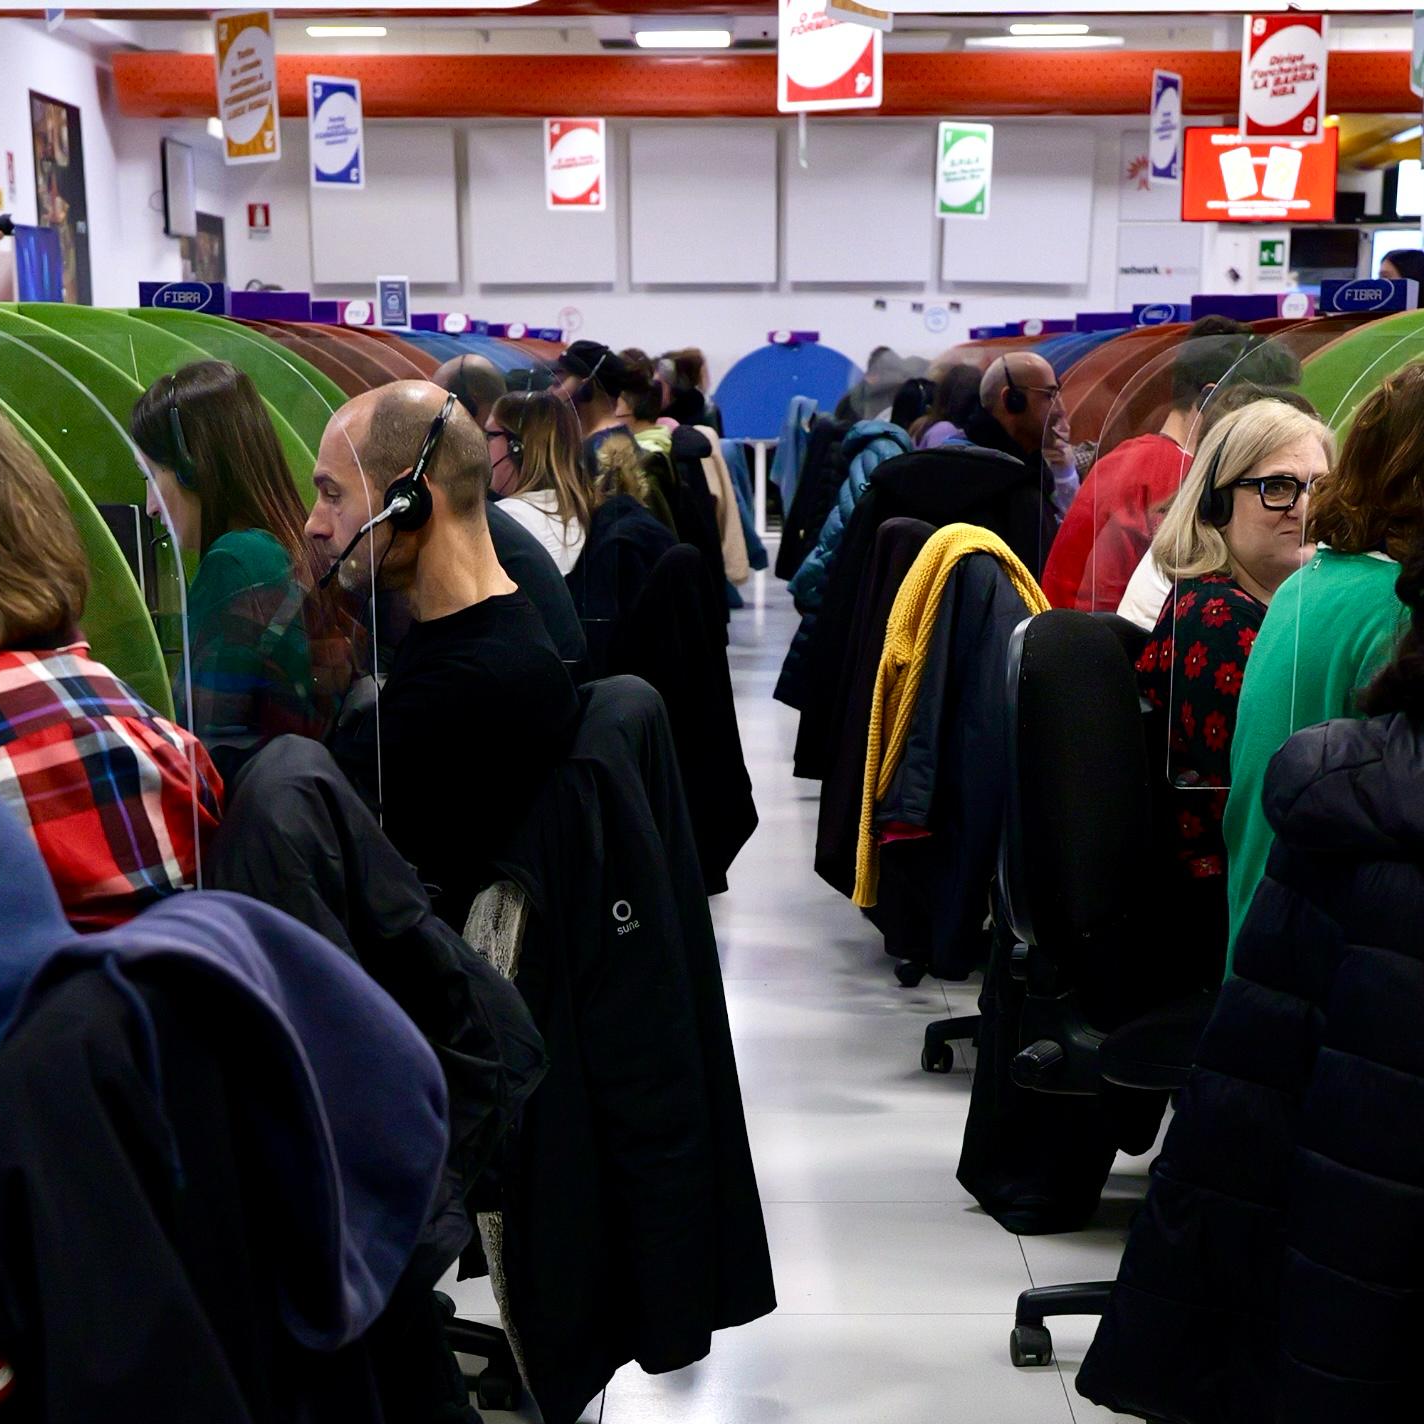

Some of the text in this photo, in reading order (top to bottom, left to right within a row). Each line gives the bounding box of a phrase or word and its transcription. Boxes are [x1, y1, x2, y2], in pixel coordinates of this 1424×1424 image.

[1252, 18, 1267, 36] 8
[1253, 79, 1268, 90] LA
[1302, 115, 1317, 134] 8
[163, 291, 201, 304] FIBRA
[1344, 288, 1383, 302] FIBRA
